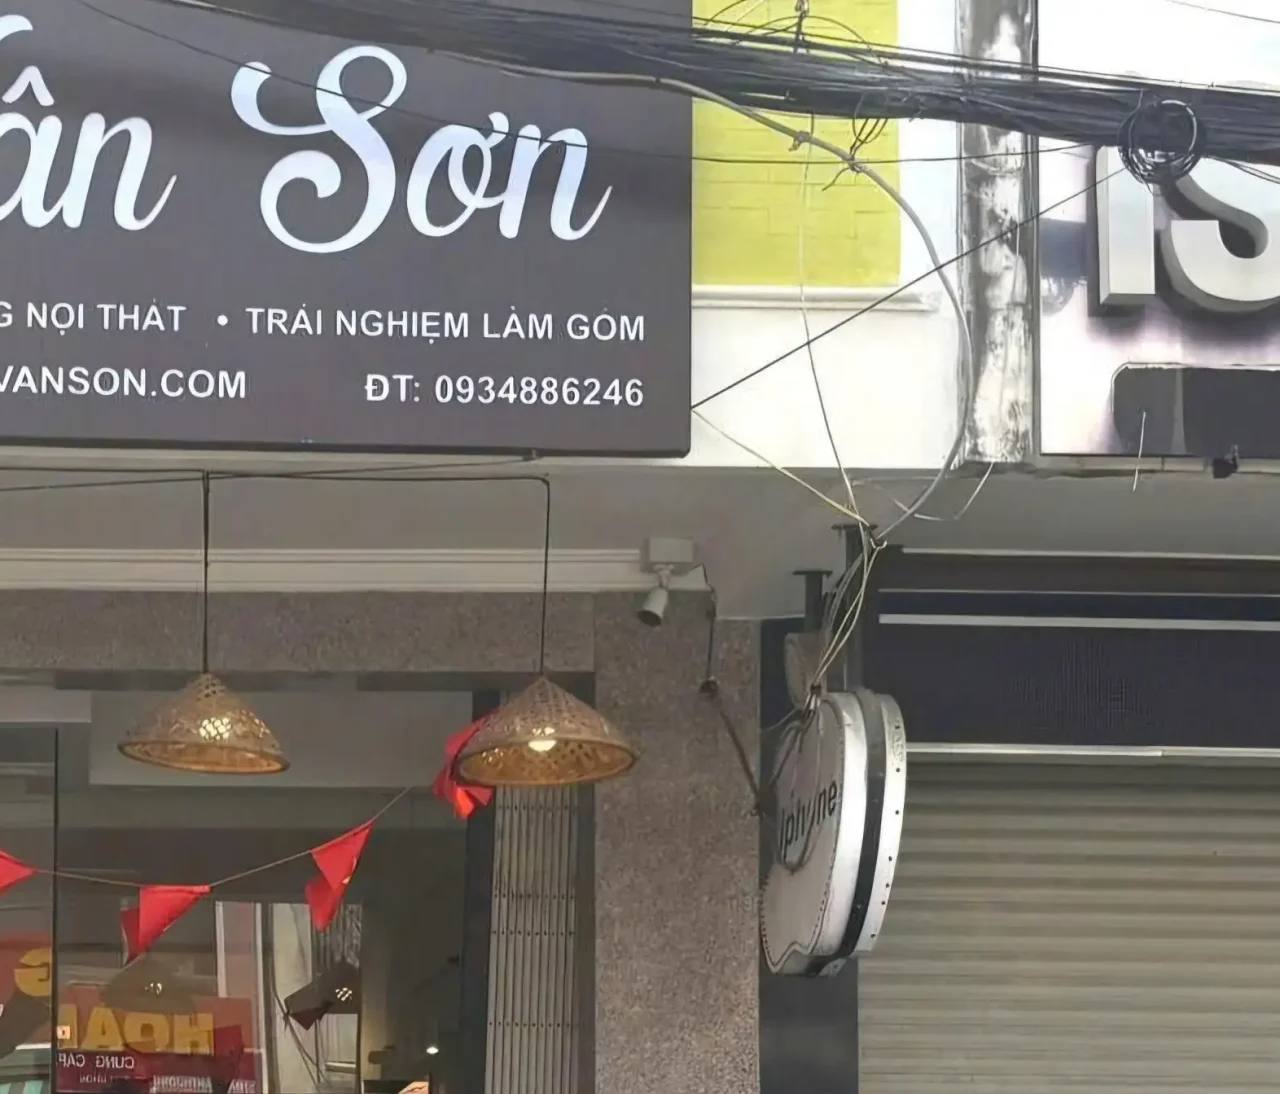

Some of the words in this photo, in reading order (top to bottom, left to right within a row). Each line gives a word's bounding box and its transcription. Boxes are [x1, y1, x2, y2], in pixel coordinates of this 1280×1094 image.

[230, 45, 612, 254] Sơn
[483, 305, 553, 340] LÀM
[364, 373, 421, 403] ĐT:
[435, 374, 644, 407] 0934886246
